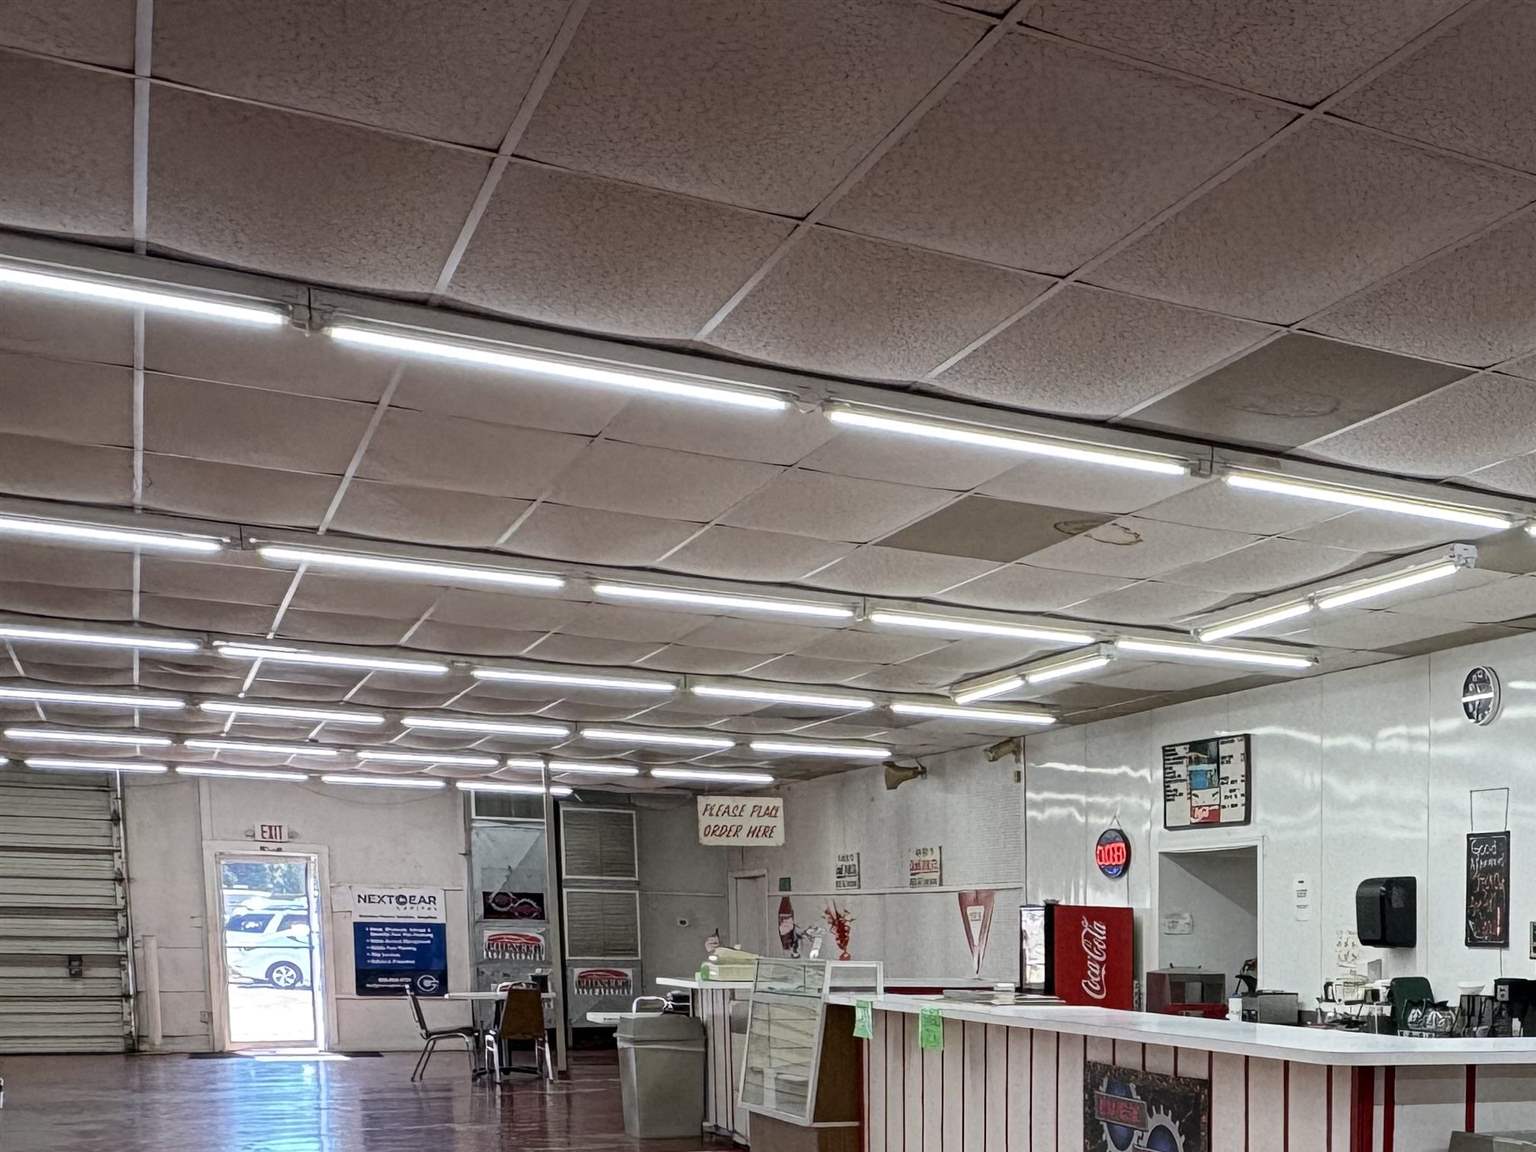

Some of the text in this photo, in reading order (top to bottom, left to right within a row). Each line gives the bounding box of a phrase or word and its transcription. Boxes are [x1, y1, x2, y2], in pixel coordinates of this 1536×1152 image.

[702, 803, 746, 817] PLEASE
[260, 824, 282, 840] EXIT
[703, 824, 777, 838] ORDER HERE
